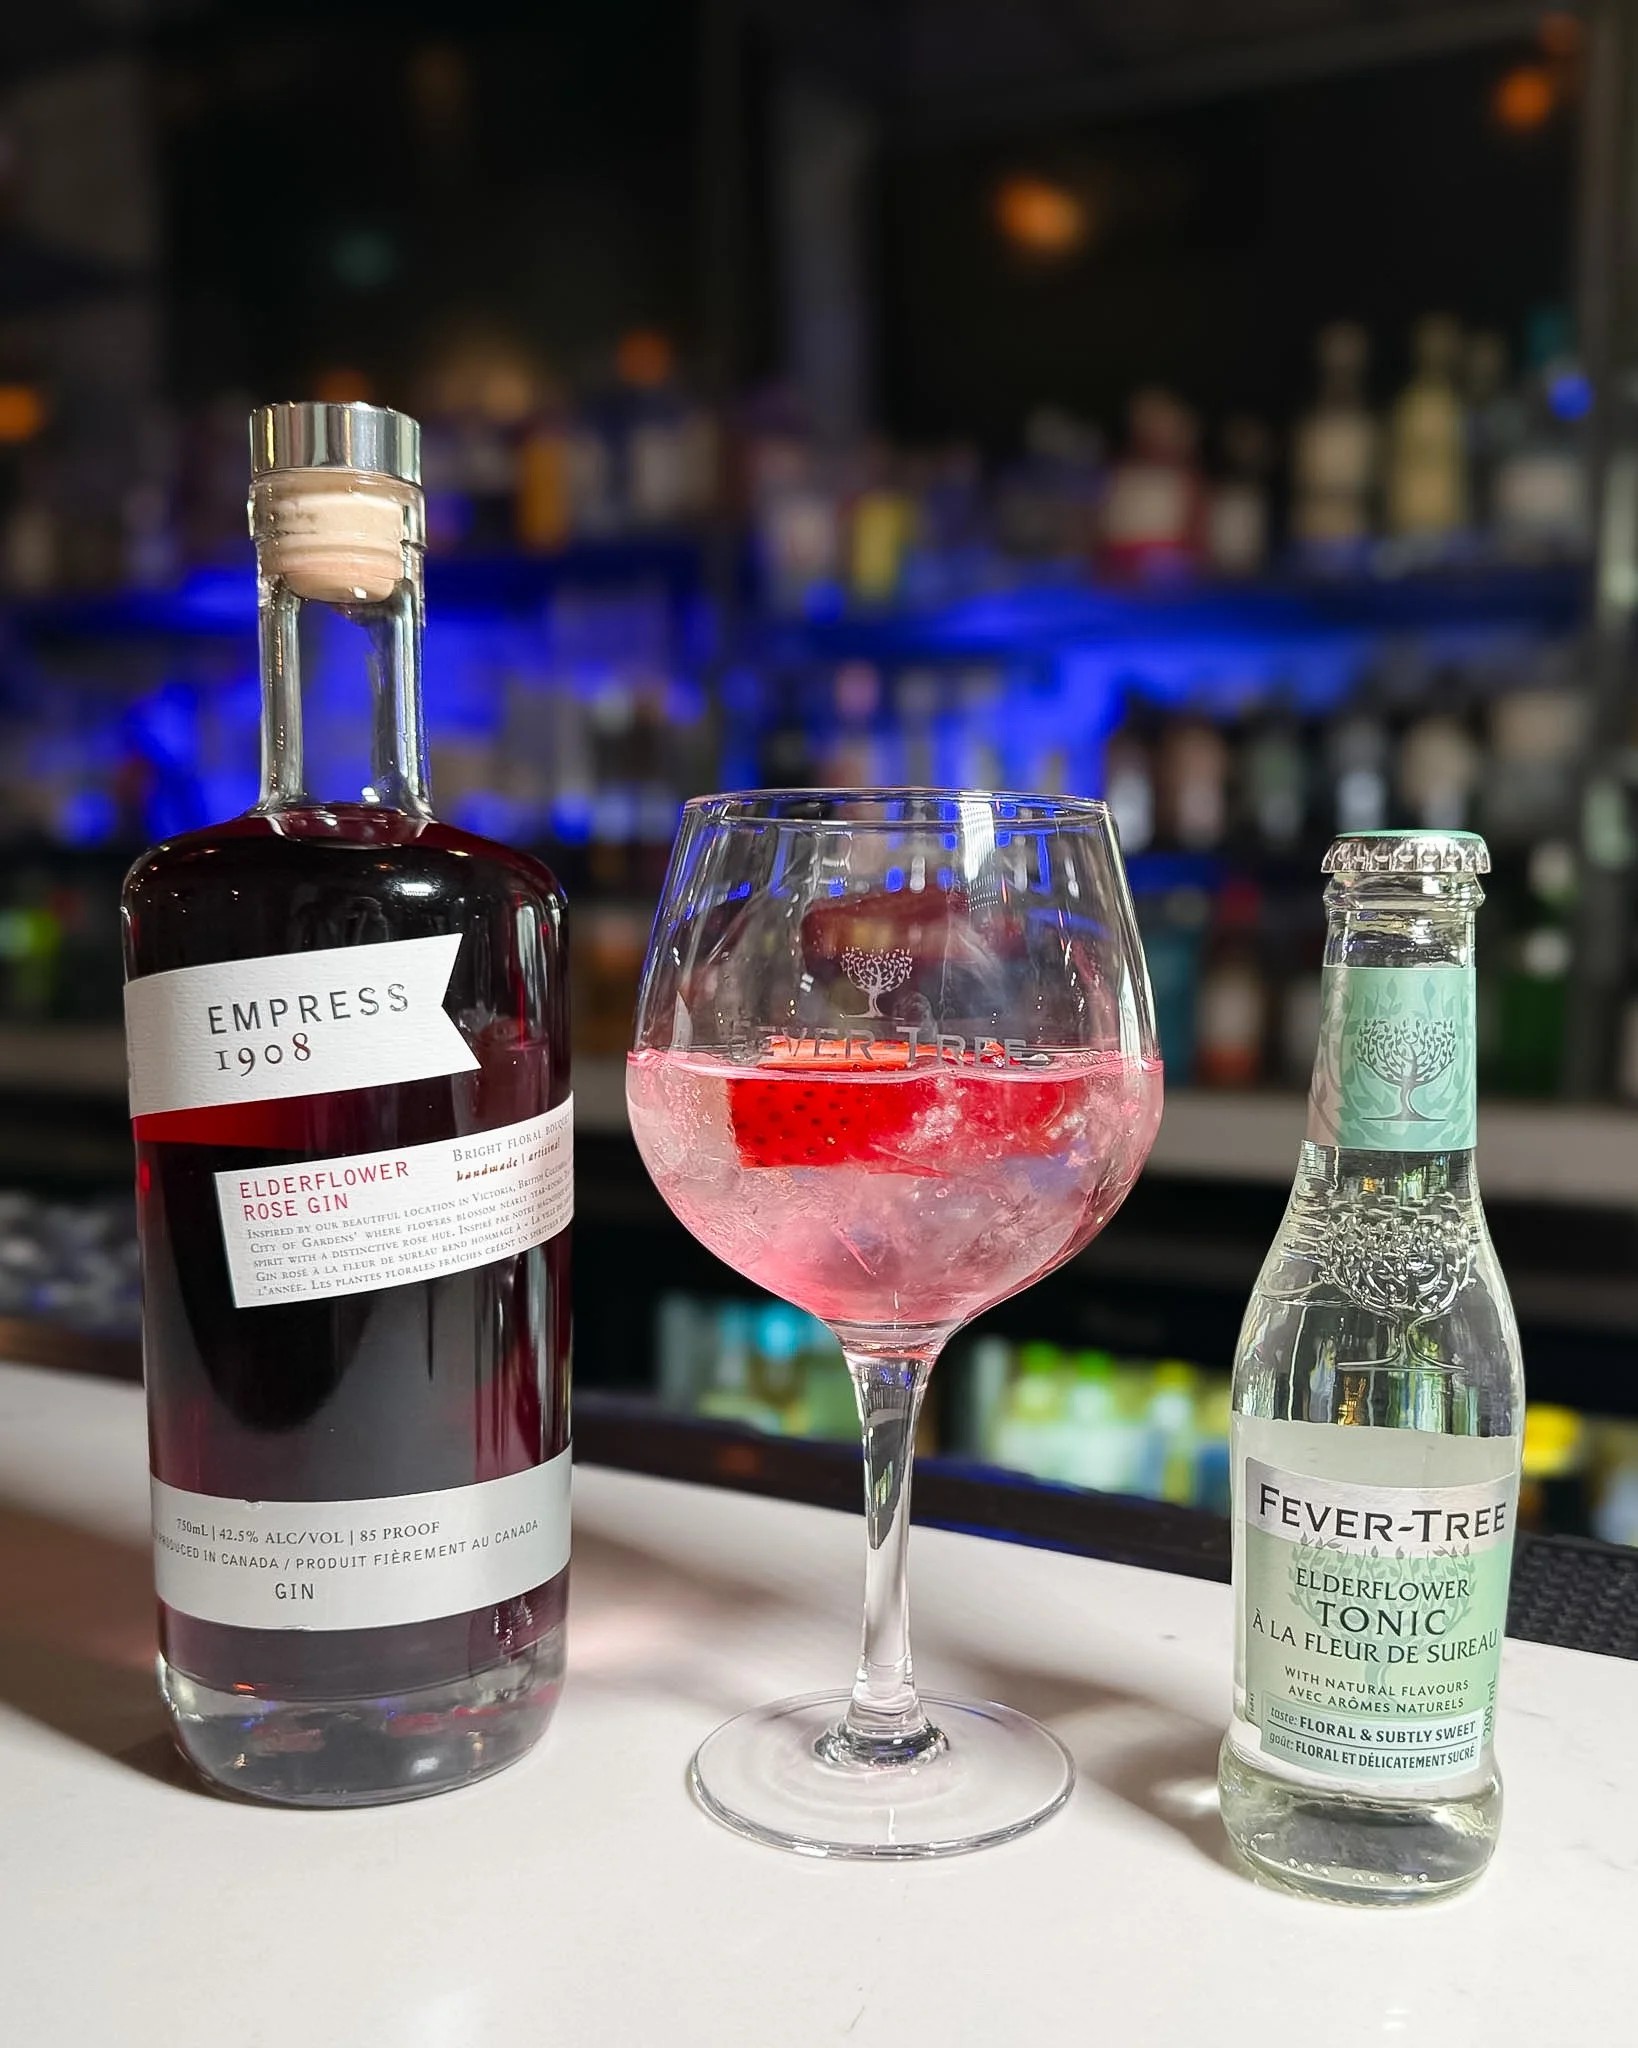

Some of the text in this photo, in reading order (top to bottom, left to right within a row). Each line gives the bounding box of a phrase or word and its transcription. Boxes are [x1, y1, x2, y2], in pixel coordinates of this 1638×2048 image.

[208, 983, 409, 1035] EMPRESS
[215, 1032, 312, 1077] 1908
[453, 1142, 502, 1163] BRIGHT
[456, 1156, 518, 1182] handmade
[240, 1161, 410, 1199] ELDERFLOWER
[244, 1193, 348, 1221] ROSE GIN
[248, 1227, 294, 1239] INSPIRED
[296, 1225, 310, 1234] BY
[315, 1221, 338, 1231] OUR
[343, 1212, 400, 1228] BEAUTIFUL
[404, 1200, 455, 1218] LOCATION
[459, 1198, 469, 1206] IN
[472, 1186, 516, 1202] VICTORIA,
[250, 1243, 276, 1253] CITY
[282, 1241, 296, 1250] OF
[365, 1226, 401, 1239] WHERE
[407, 1217, 452, 1232] FLOWERS
[456, 1205, 496, 1222] BLOSSOM
[254, 1257, 284, 1268] SPIRIT
[288, 1254, 316, 1264] WITH
[321, 1252, 327, 1260] A
[332, 1241, 399, 1258] DISTINCTIVE
[402, 1236, 428, 1247] ROSE
[431, 1229, 455, 1241] HUE.
[256, 1272, 277, 1281] GIN
[325, 1265, 338, 1274] LA
[343, 1260, 375, 1272] FLEUR
[380, 1256, 394, 1265] DE
[398, 1246, 438, 1262] SUREAU
[441, 1241, 467, 1253] REND
[471, 1227, 513, 1246] HOMMAGE
[311, 1279, 331, 1290] LES
[335, 1272, 382, 1287] PLANTES
[385, 1263, 436, 1279] FLORALES
[176, 1517, 209, 1537] 750mL
[219, 1529, 259, 1544] 42.5%
[265, 1530, 344, 1545] ALC/VOL
[359, 1529, 376, 1543] 85
[383, 1521, 440, 1540] PROOF
[1259, 1482, 1507, 1543] FEVER-TREE
[203, 1550, 216, 1563] IN
[221, 1553, 279, 1569] CANADA
[296, 1555, 368, 1570] PRODUIT
[374, 1541, 466, 1567] FIÈREMENT
[471, 1536, 489, 1550] AU
[494, 1519, 539, 1545] CANADA
[275, 1583, 315, 1600] GIN
[1296, 1567, 1470, 1602] ELDERFLOWER
[1252, 1607, 1498, 1664] À LA FLEUR DE SUREAU
[1315, 1600, 1447, 1637] TONIC
[1284, 1665, 1469, 1697] WITH NATURAL FLAVOURS
[1288, 1686, 1464, 1713] AVEC ARÔMES NATURELS
[1270, 1707, 1476, 1744] taste: FLORAL & SUBTLY SWEET
[1268, 1732, 1475, 1769] goût: FLORAL ET DÉLICATEMENT SUCRÉ
